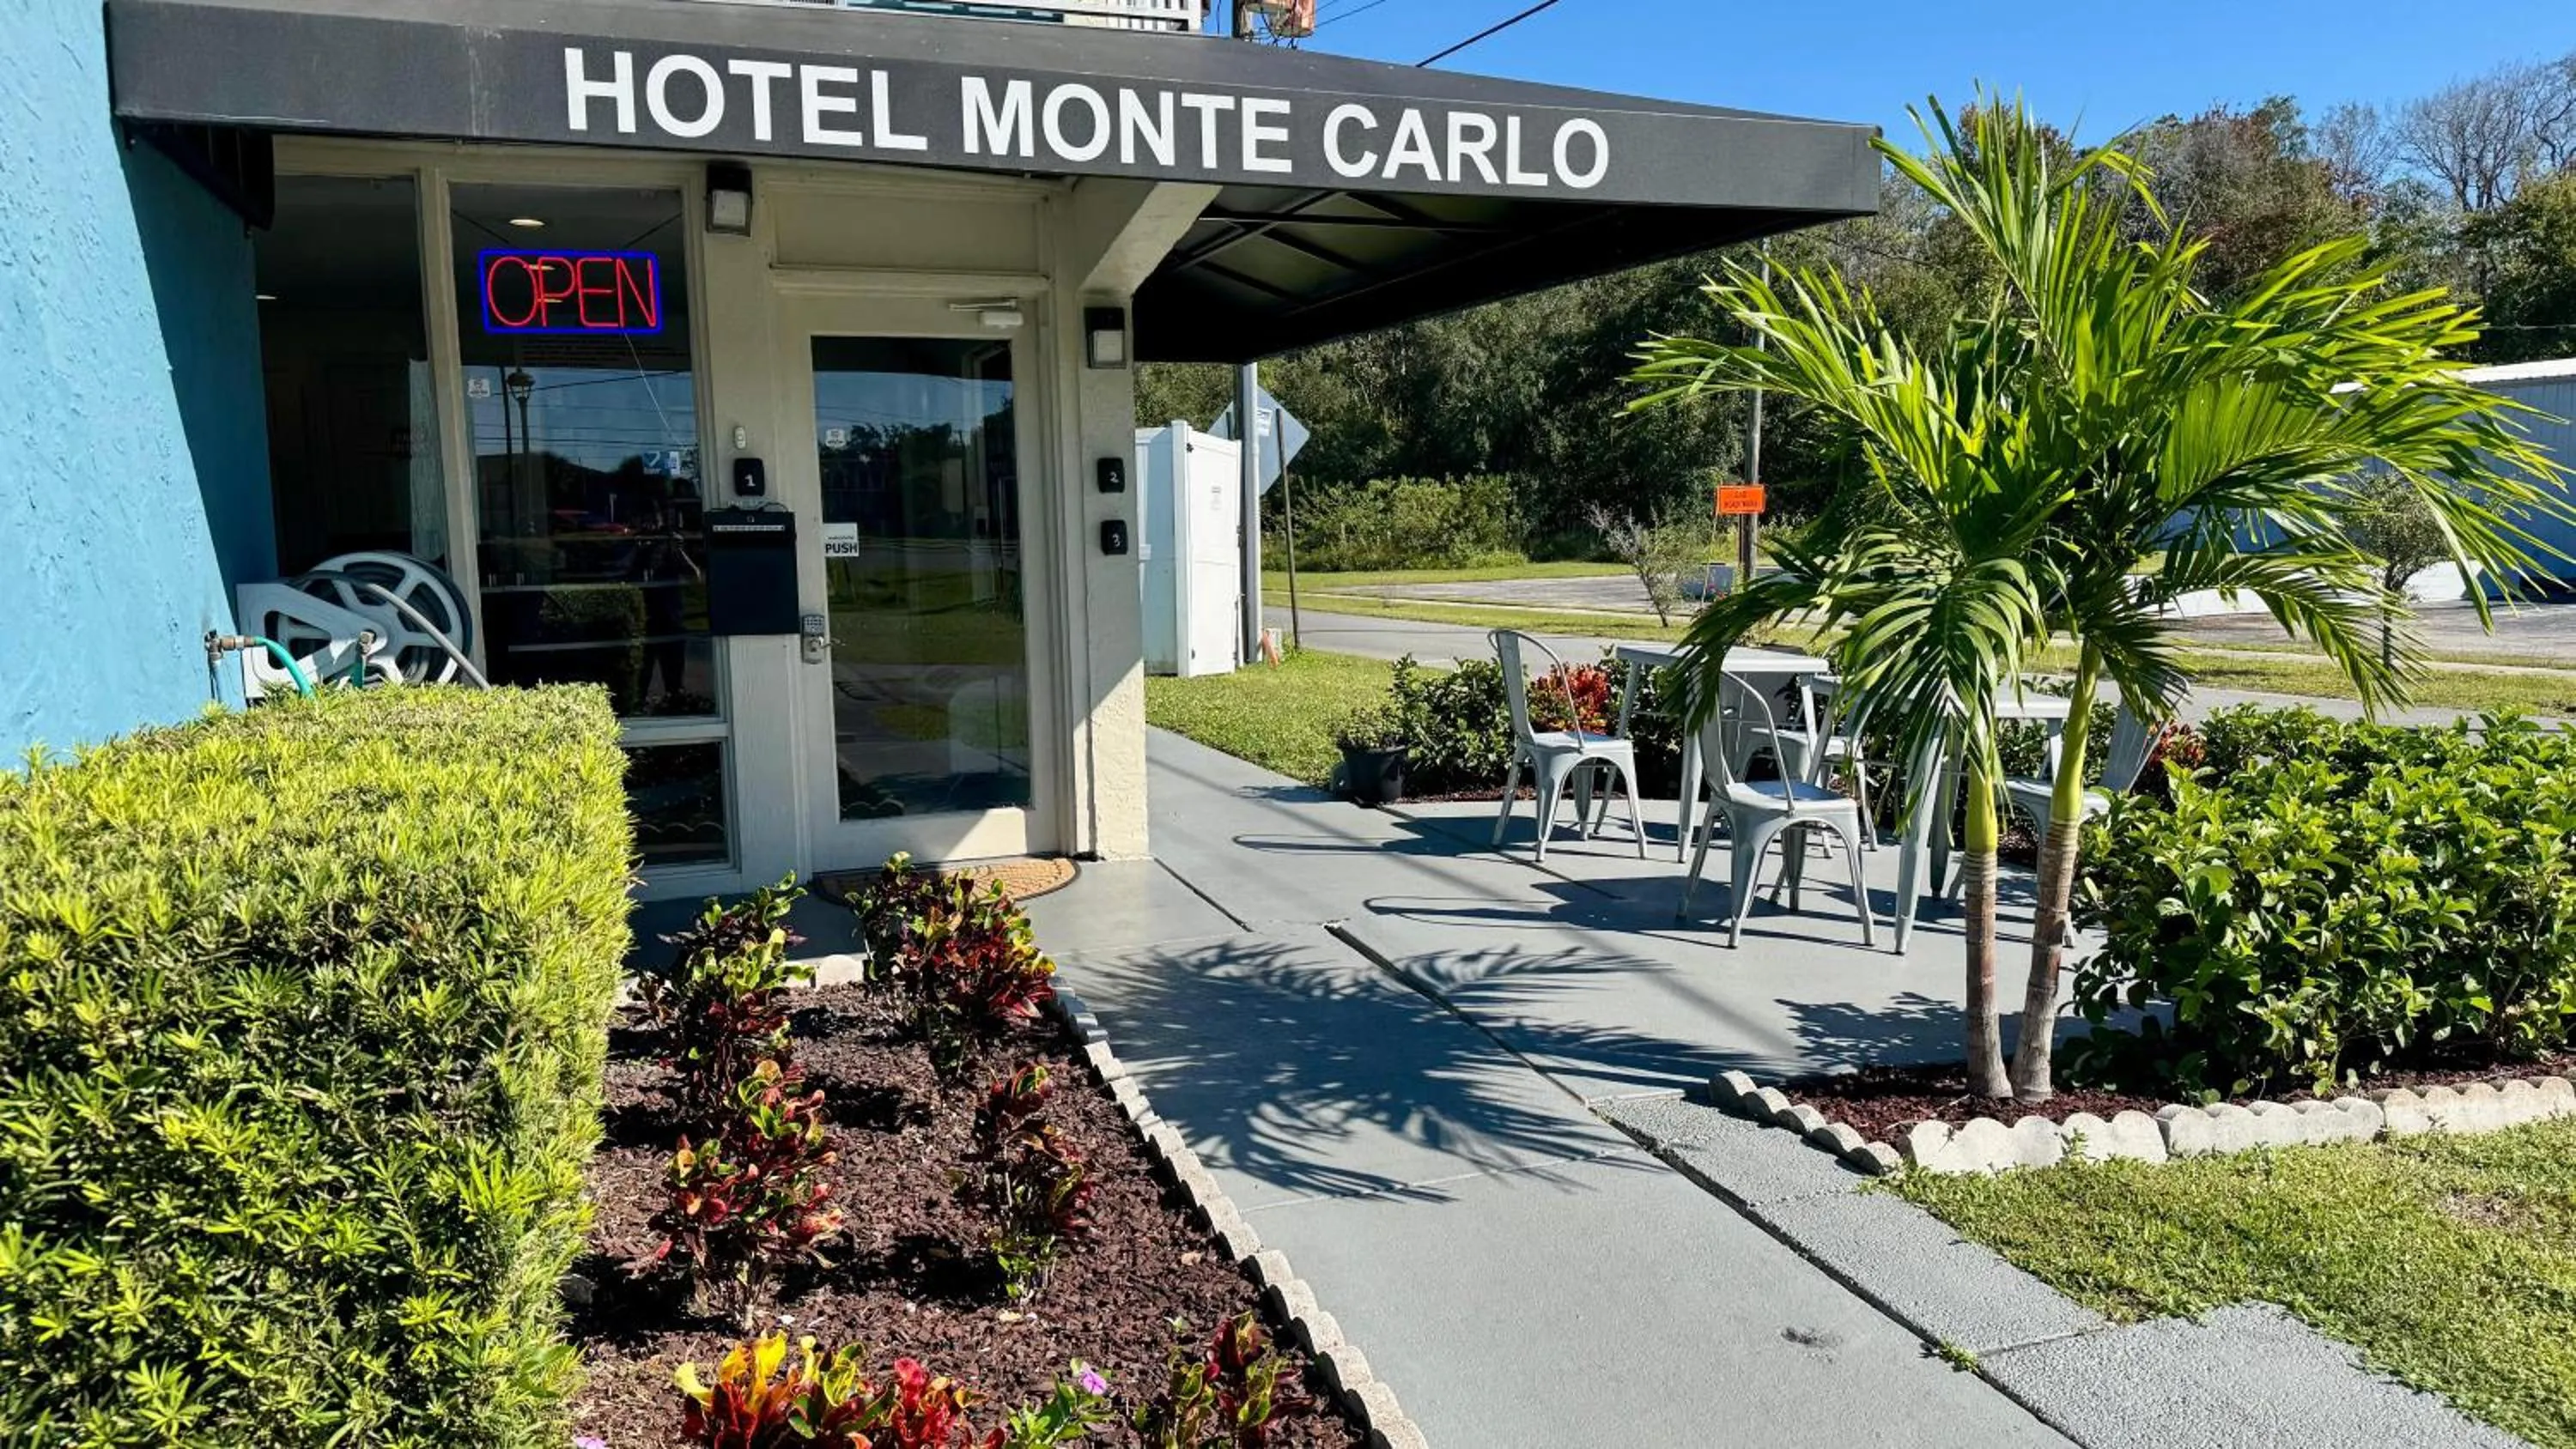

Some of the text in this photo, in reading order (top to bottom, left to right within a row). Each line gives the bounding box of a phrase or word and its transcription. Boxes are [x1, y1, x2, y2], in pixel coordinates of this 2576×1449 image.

[564, 47, 1609, 189] HOTEL MONTE CARLO
[487, 256, 656, 327] OPEN
[744, 473, 756, 488] 1
[1109, 470, 1120, 483] 2
[1112, 533, 1121, 548] 3
[825, 543, 858, 554] PUSH
